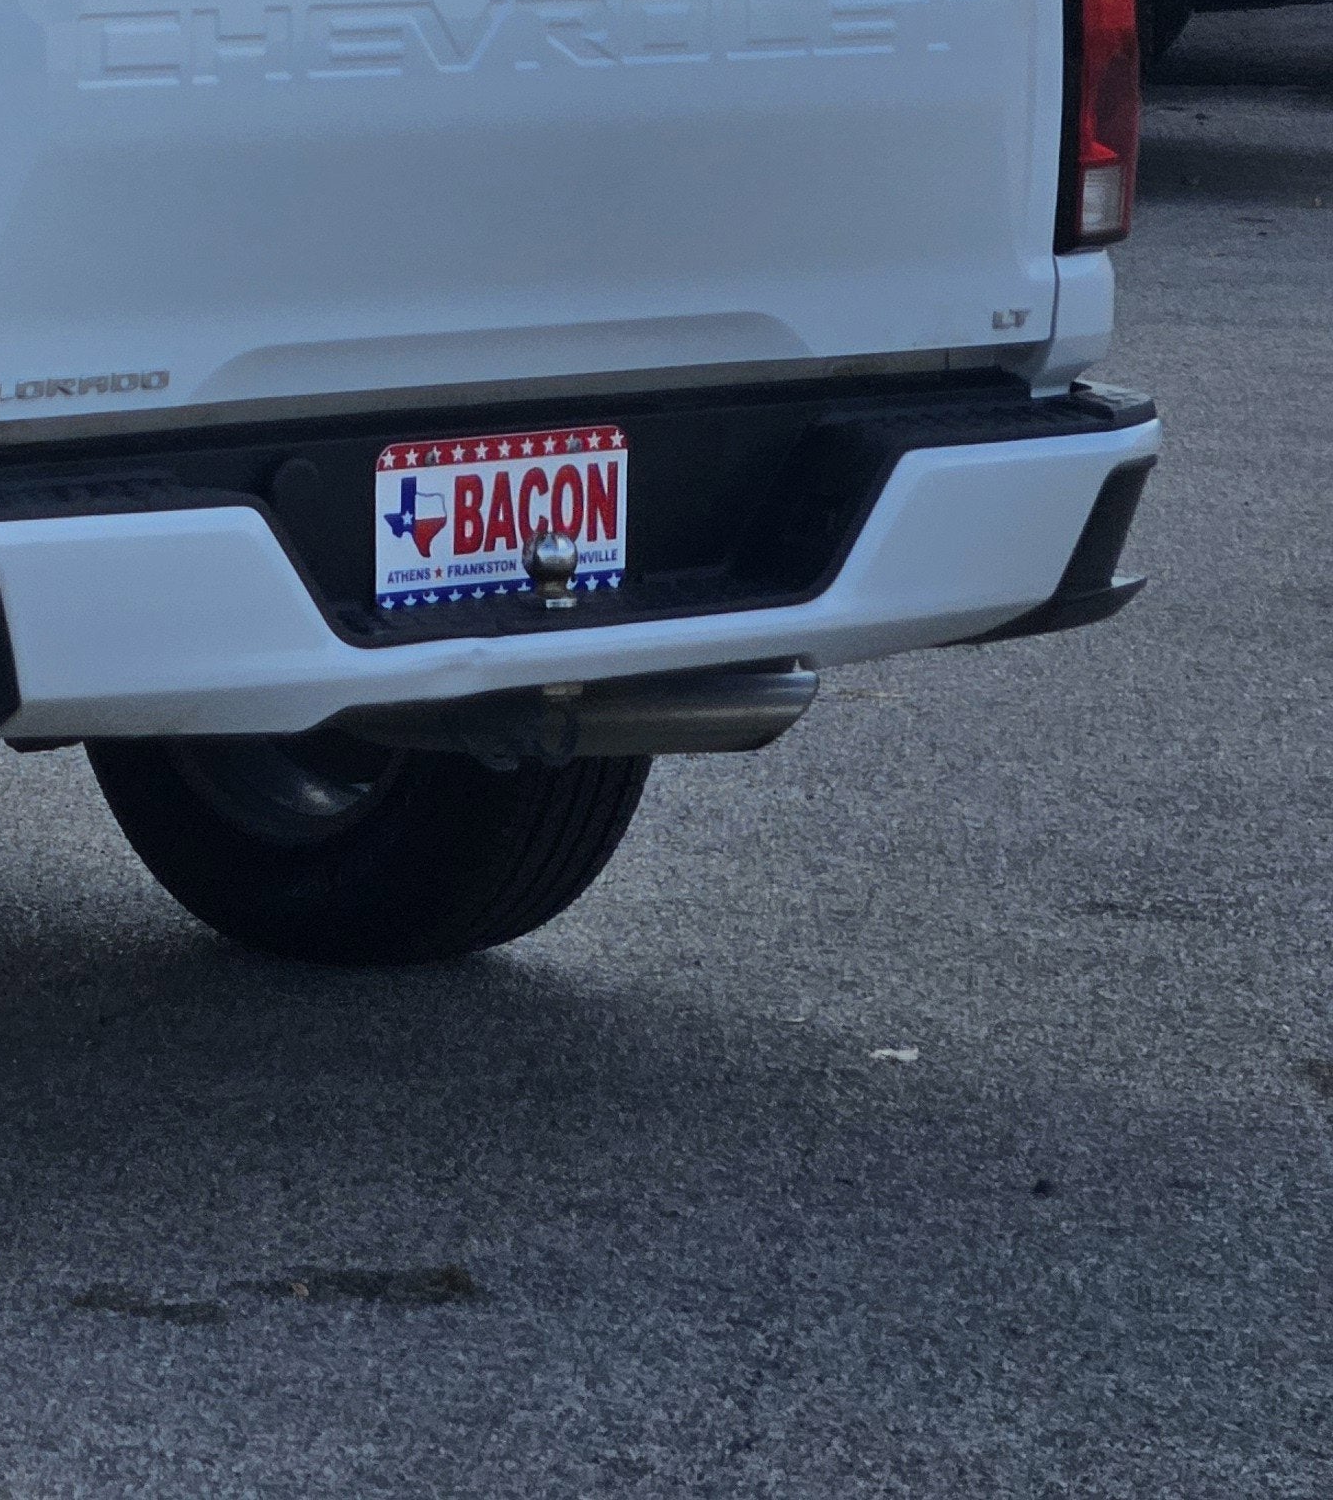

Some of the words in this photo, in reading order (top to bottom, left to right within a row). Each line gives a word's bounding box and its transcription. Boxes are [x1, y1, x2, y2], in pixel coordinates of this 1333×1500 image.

[992, 308, 1031, 330] LT
[453, 461, 619, 556] BACON
[387, 567, 432, 585] ATHENS
[447, 559, 517, 578] FRANKSTON
